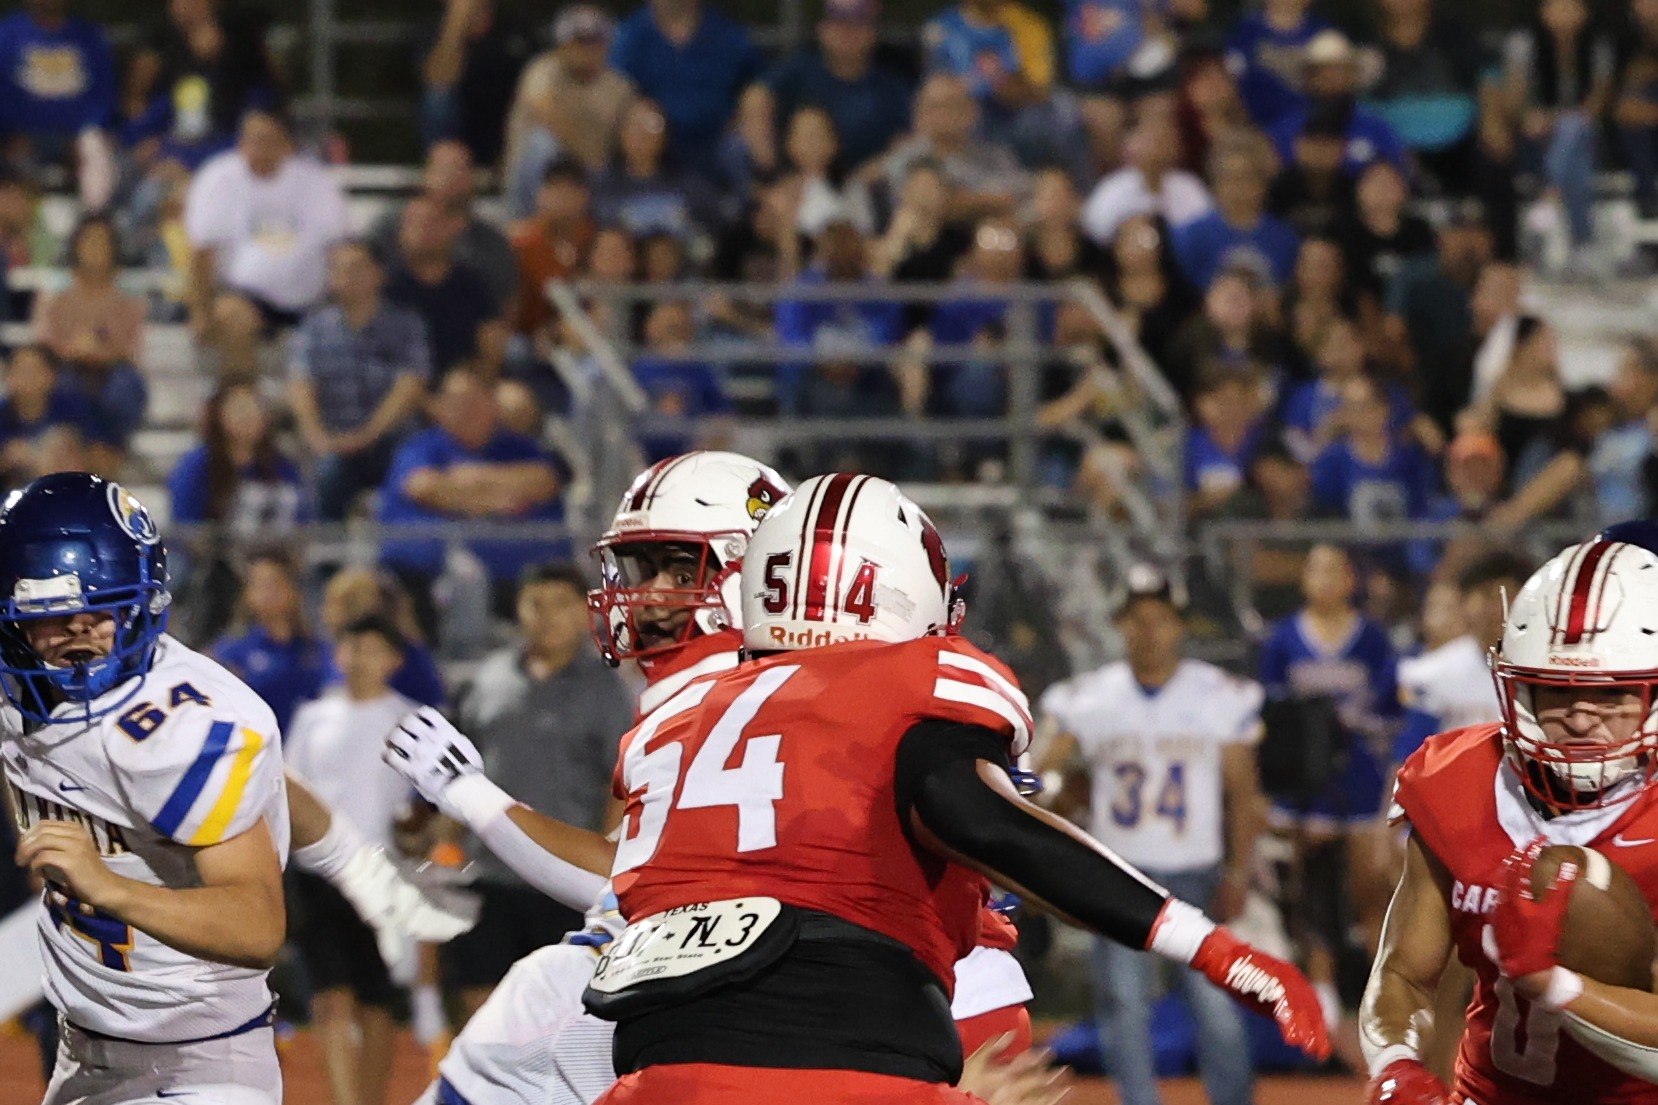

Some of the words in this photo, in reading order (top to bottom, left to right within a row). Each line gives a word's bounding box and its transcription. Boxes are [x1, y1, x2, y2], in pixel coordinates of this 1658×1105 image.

[117, 682, 213, 743] 64
[612, 665, 801, 878] 54
[1110, 760, 1189, 837] 34
[663, 902, 709, 918] TEXAS
